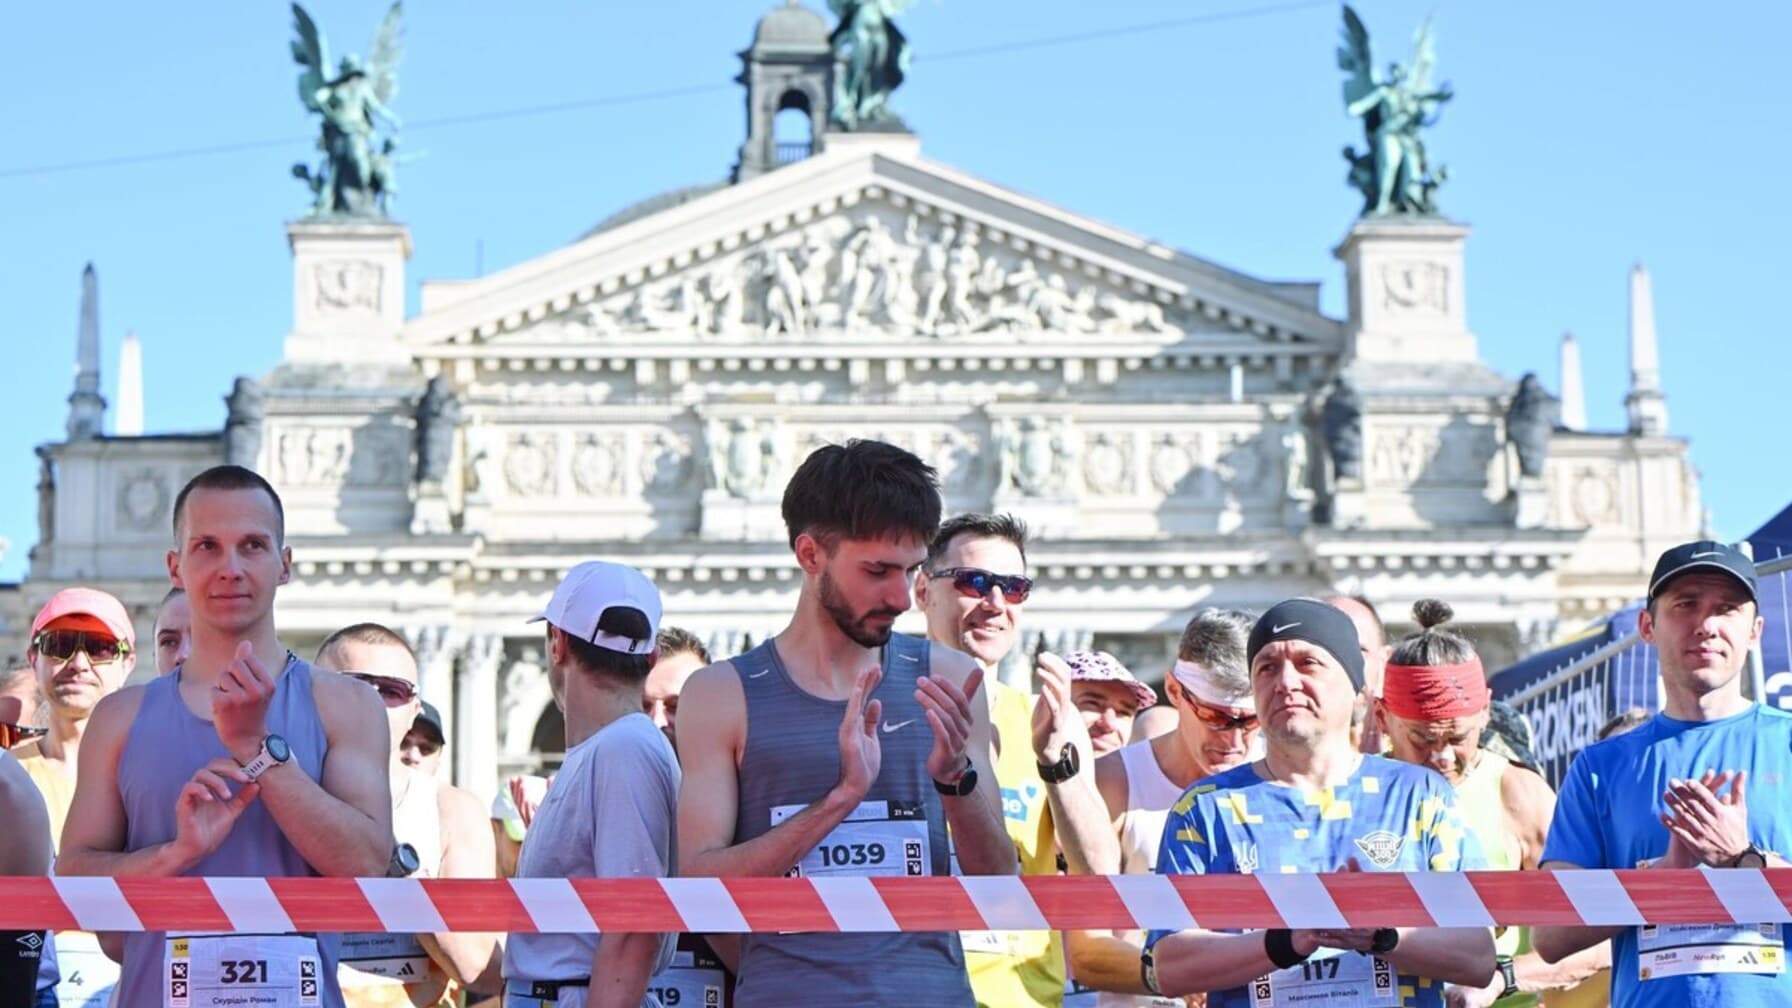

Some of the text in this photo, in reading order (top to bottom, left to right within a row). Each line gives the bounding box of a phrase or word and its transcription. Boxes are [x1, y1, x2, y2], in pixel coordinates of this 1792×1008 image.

[819, 843, 886, 867] 1039
[221, 960, 268, 984] 321
[1303, 958, 1341, 981] 117
[647, 987, 681, 1006] 19
